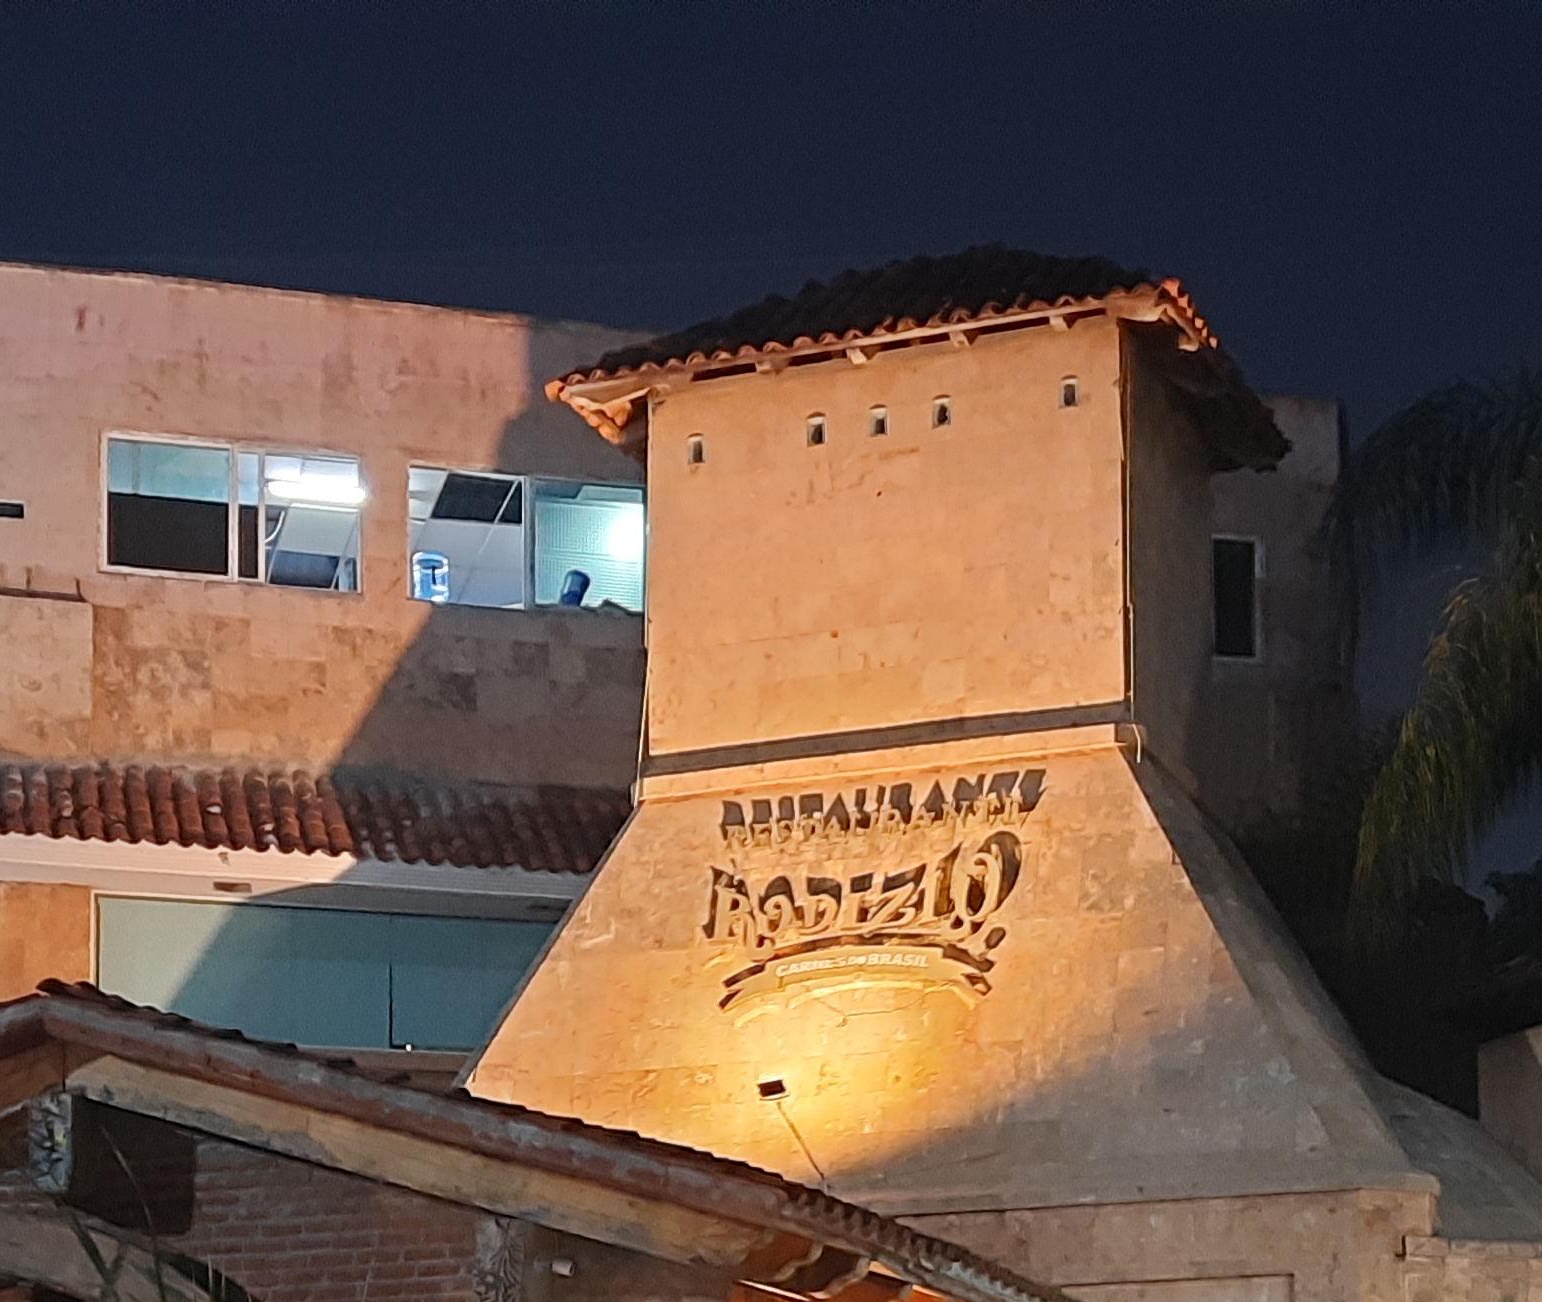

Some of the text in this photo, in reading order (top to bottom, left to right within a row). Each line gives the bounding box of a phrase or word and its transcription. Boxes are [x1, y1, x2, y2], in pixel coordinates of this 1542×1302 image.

[722, 781, 1032, 849] RESTAURANTE
[706, 848, 1008, 960] RODIZIO
[867, 952, 929, 968] BRASIL
